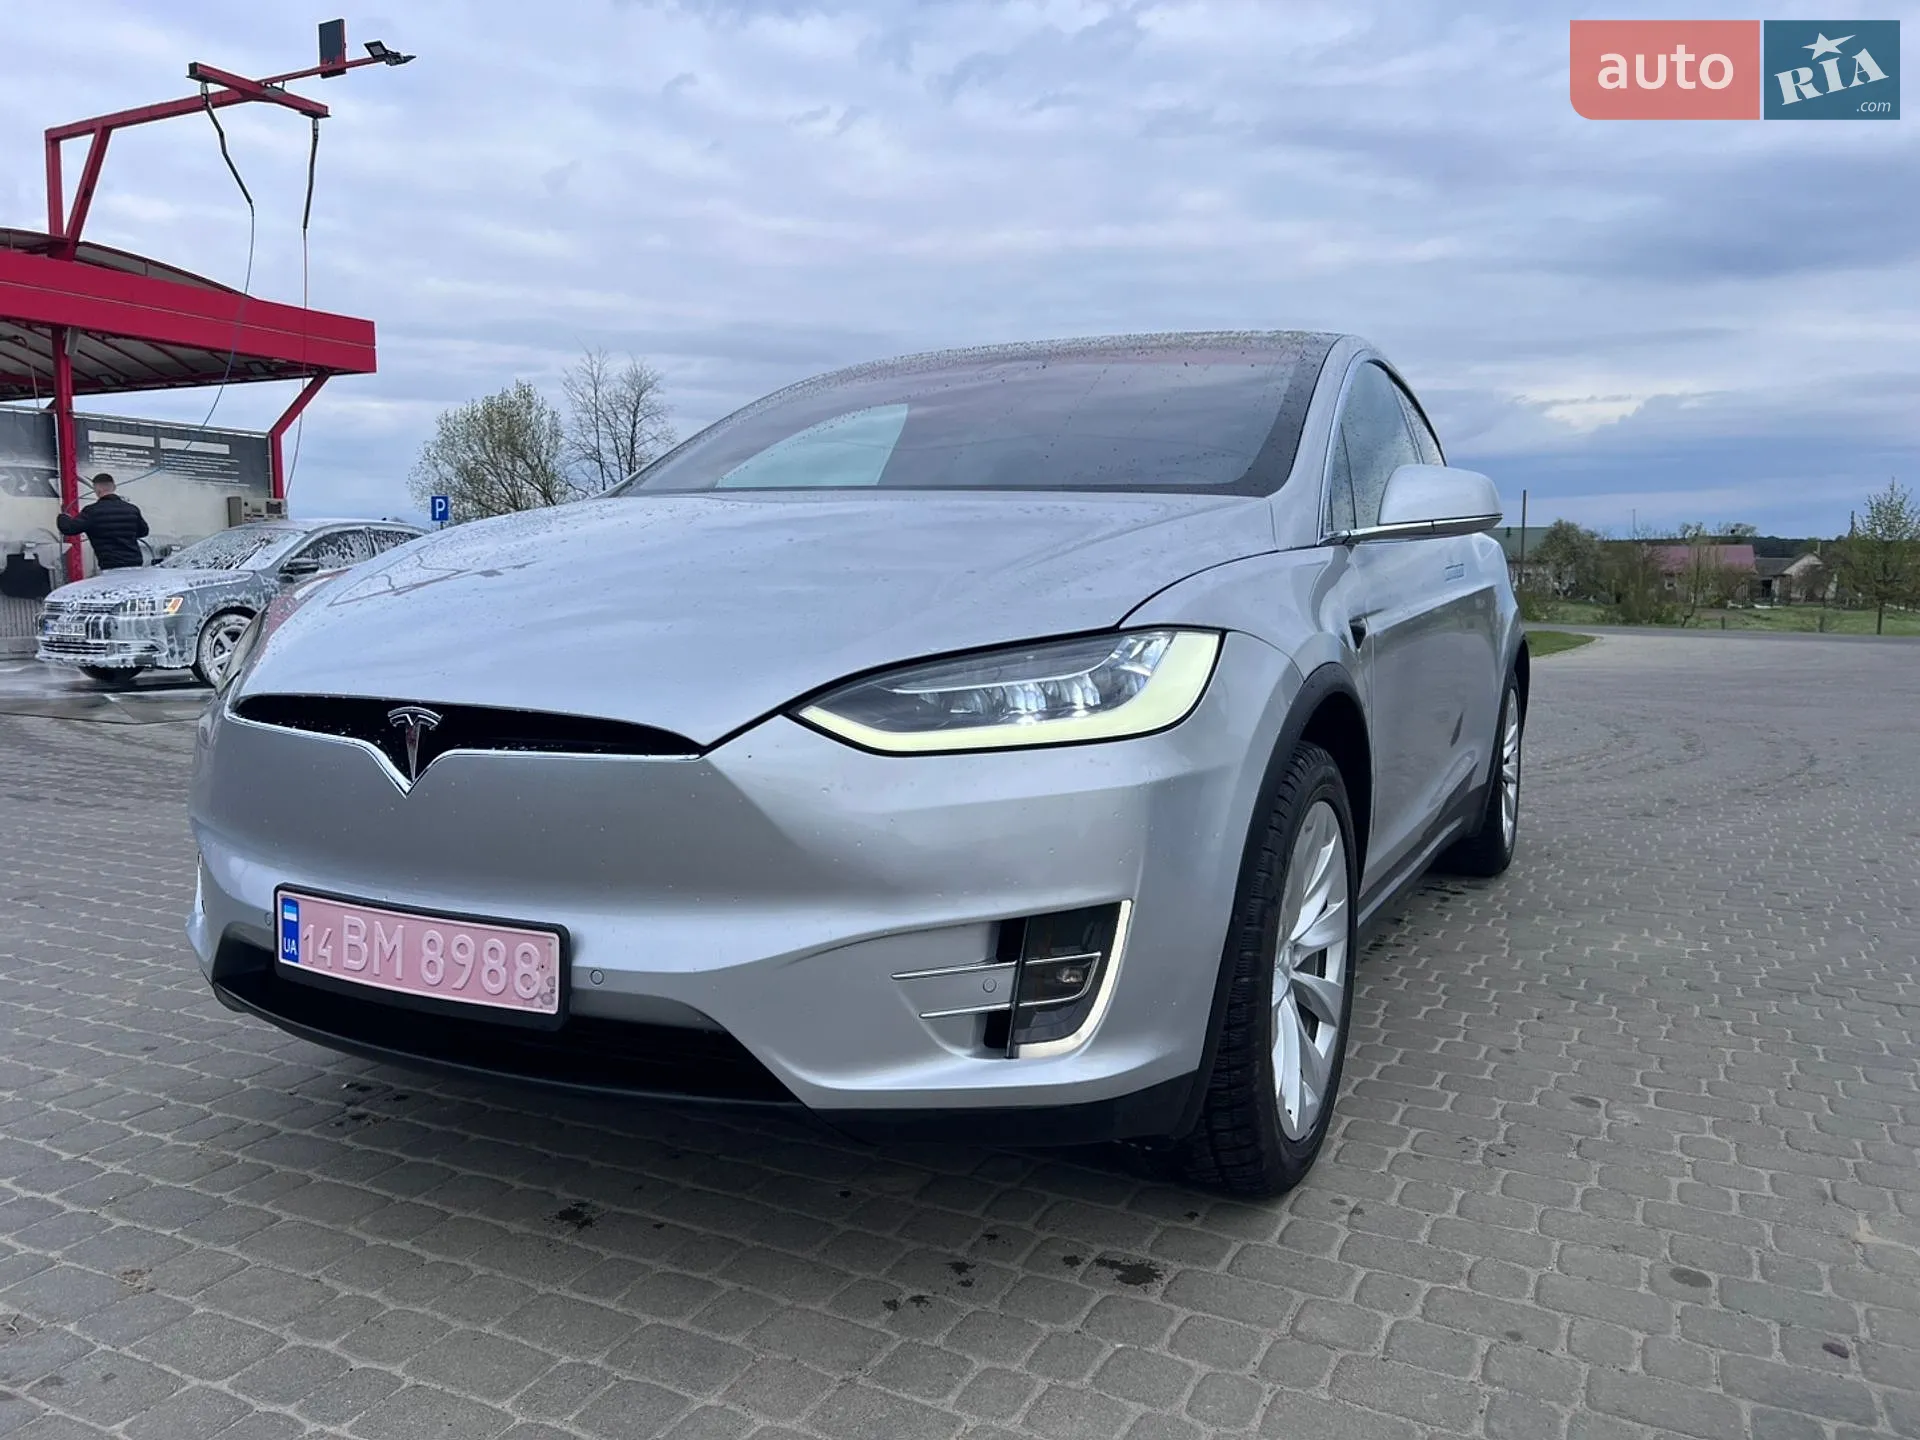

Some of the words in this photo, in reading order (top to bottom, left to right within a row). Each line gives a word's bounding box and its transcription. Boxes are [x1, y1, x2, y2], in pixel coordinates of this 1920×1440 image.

[435, 498, 446, 519] P
[283, 937, 298, 956] UA
[420, 929, 541, 1000] 8988
